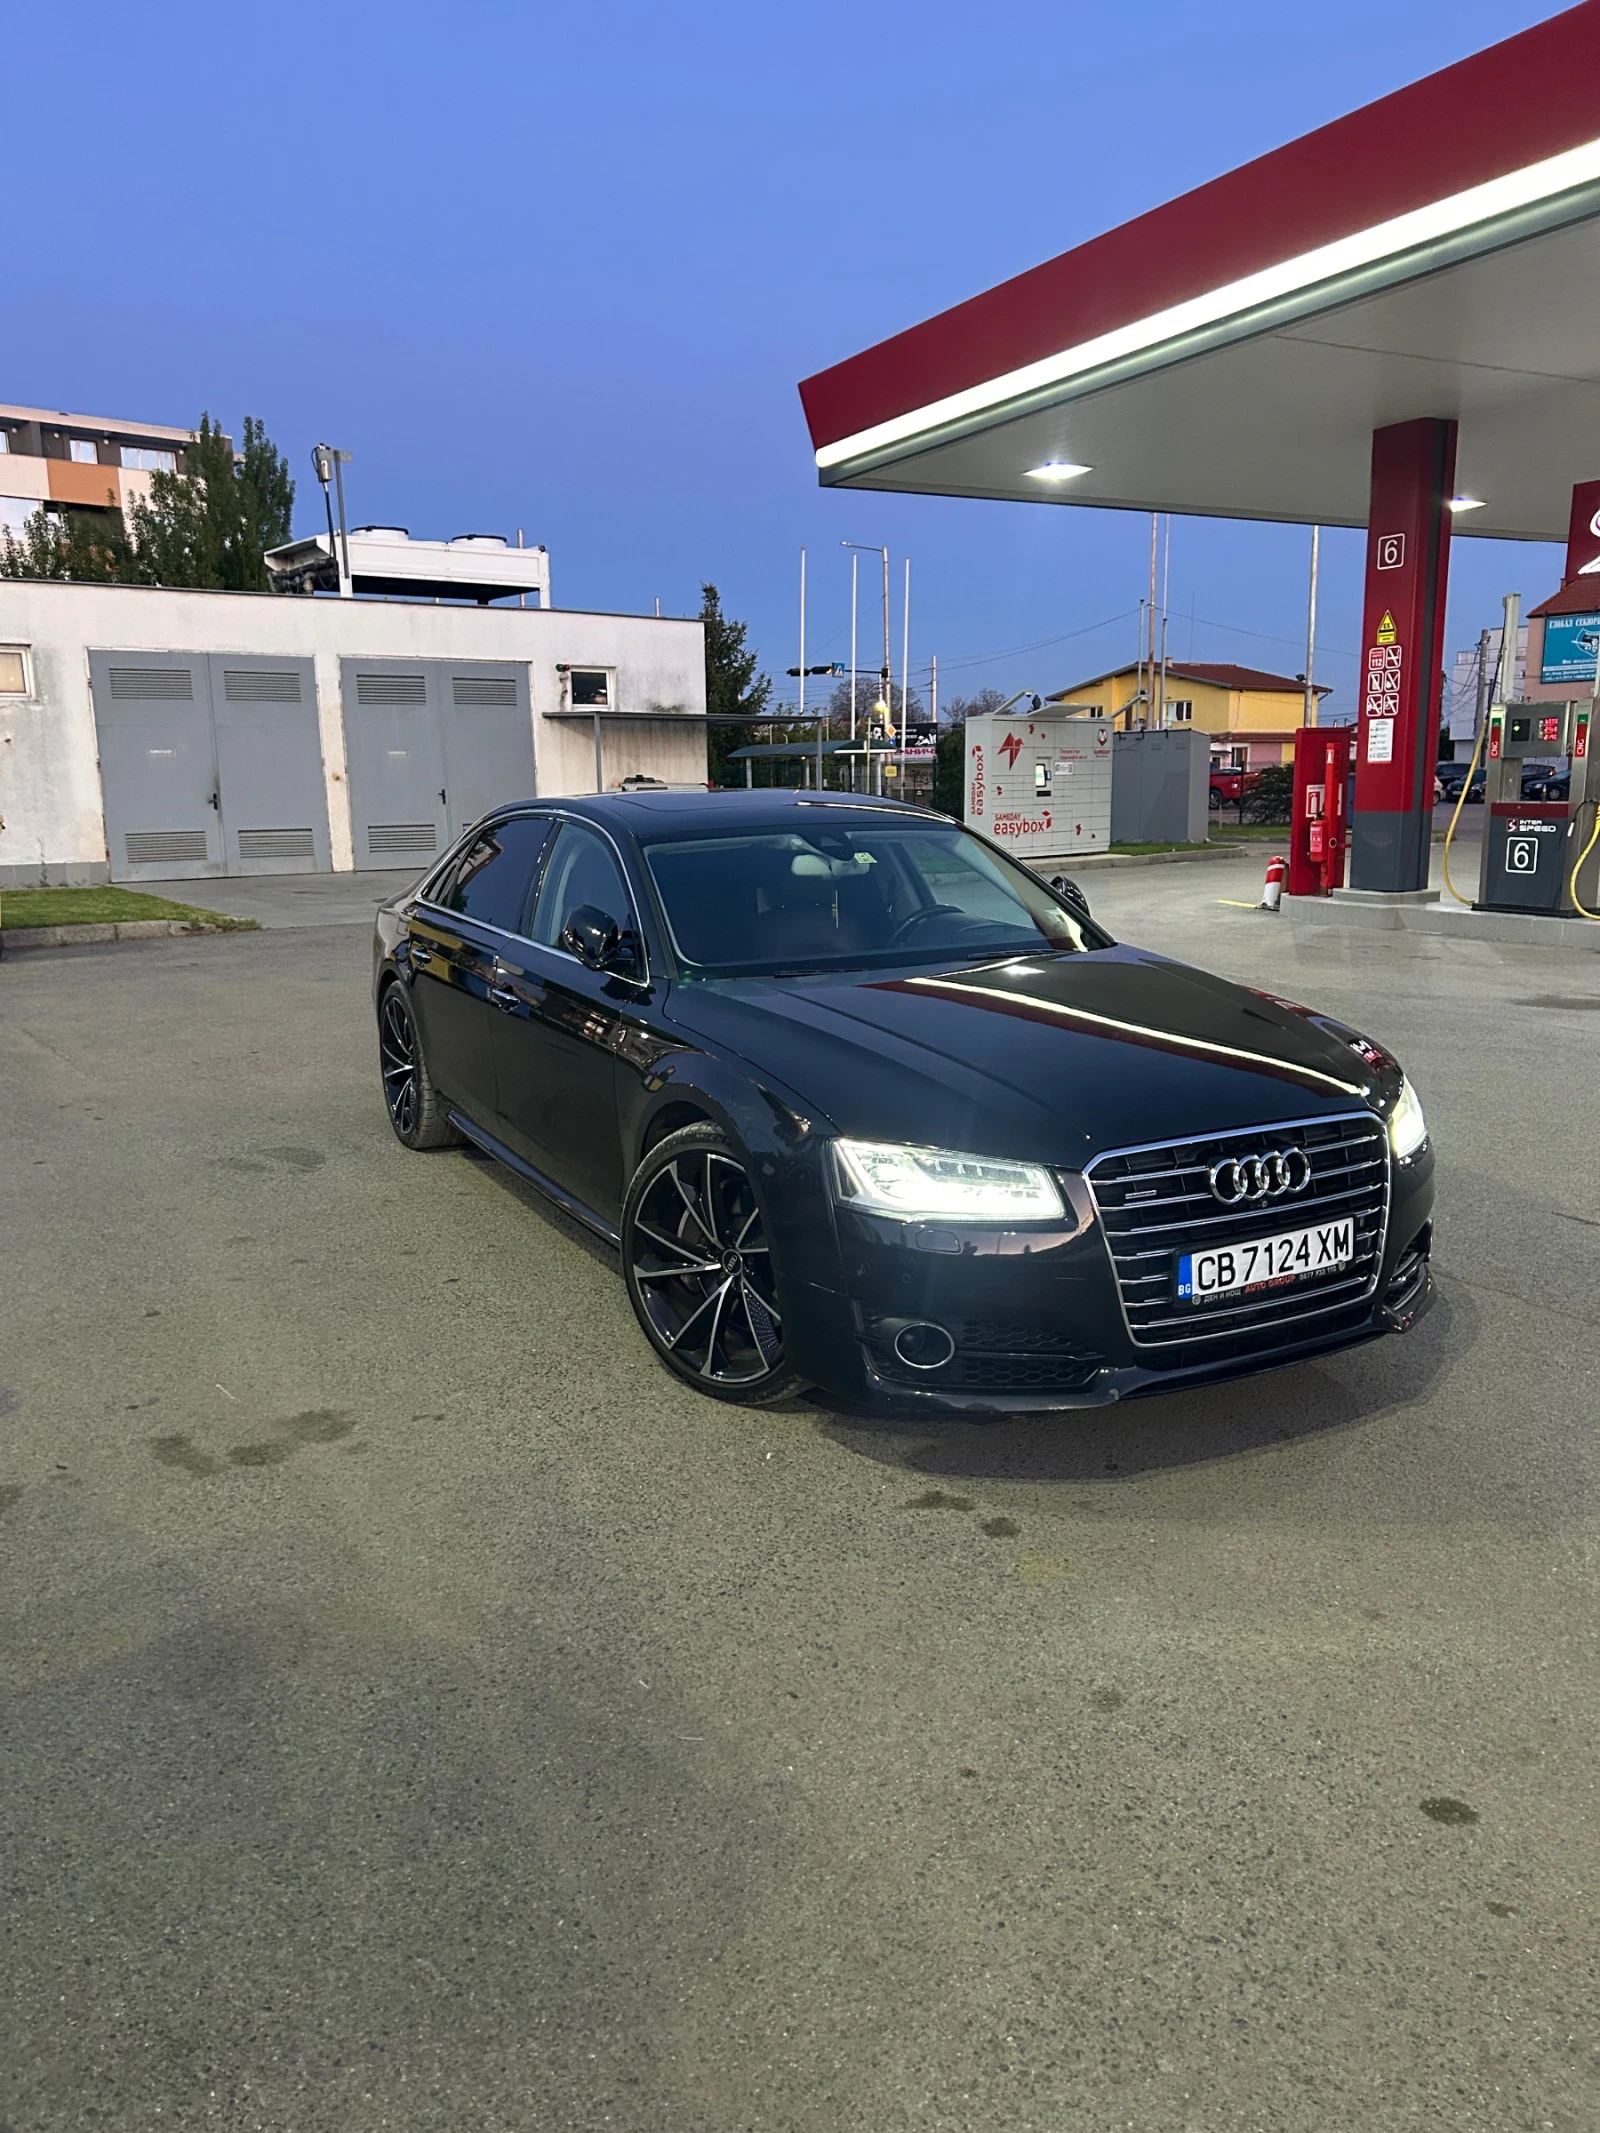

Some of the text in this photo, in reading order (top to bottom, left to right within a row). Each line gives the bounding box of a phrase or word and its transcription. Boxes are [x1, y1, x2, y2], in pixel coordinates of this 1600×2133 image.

[1385, 539, 1398, 564] 6
[1371, 658, 1382, 667] 112
[1576, 739, 1585, 755] CNG
[974, 754, 986, 816] easybox
[995, 813, 1021, 821] SAMEDAY
[994, 818, 1045, 838] easybox
[1519, 825, 1557, 833] SPEED
[1514, 842, 1530, 868] 6
[1198, 1223, 1349, 1290] CB 7124 XM
[1178, 1283, 1191, 1296] BG
[1244, 1274, 1296, 1293] AUTO GROUP
[1203, 1288, 1241, 1303] ДЕН И НОЩ
